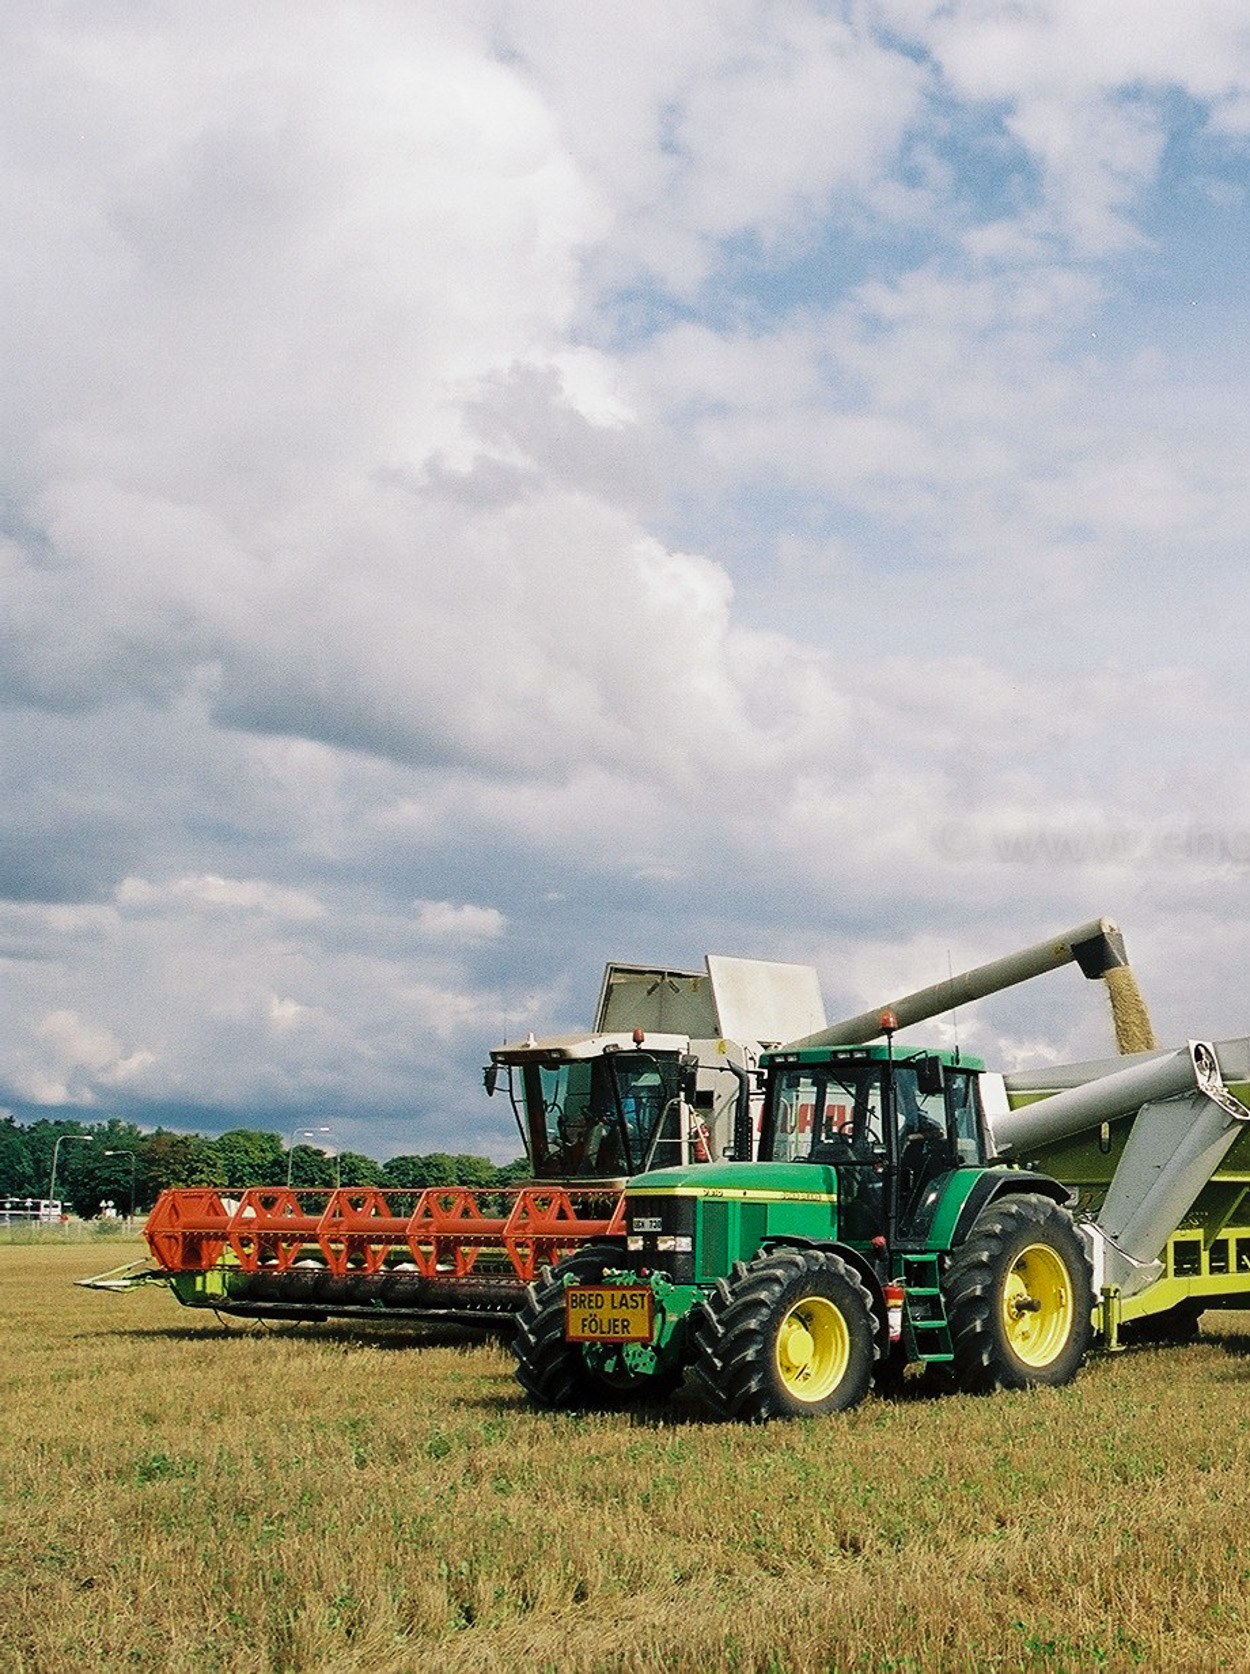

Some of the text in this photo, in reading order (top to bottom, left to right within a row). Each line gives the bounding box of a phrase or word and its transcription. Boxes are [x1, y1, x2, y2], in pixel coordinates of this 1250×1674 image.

[570, 1293, 646, 1309] BRED LAST
[581, 1313, 631, 1334] FÖLJER
